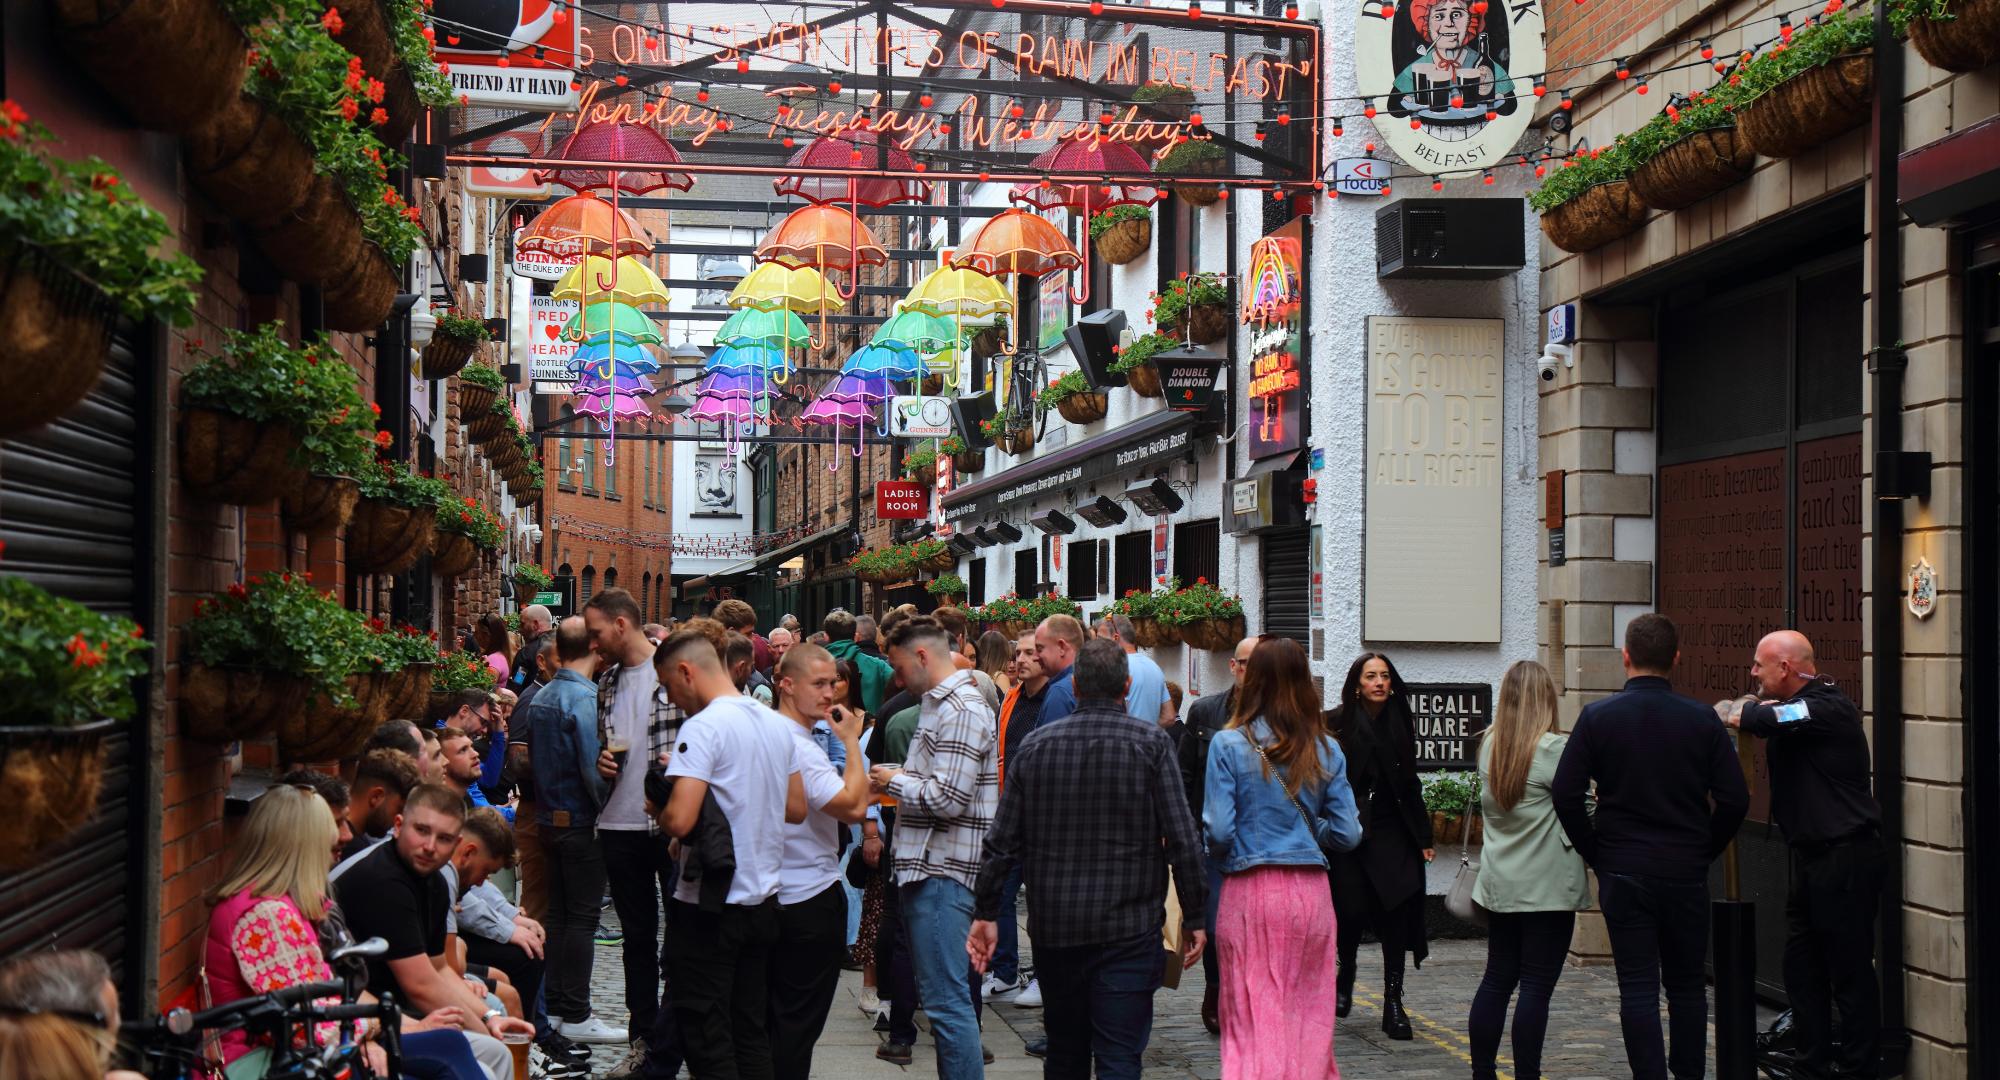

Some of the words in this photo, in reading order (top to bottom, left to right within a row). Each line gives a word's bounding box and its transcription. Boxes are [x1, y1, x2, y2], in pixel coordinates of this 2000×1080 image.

[613, 24, 691, 64] ONLY
[712, 23, 820, 64] SEVEN
[839, 26, 944, 68] TYPES
[959, 30, 1000, 69] OF
[1015, 34, 1094, 79] RAIN
[1107, 43, 1138, 84] IN
[452, 72, 503, 91] FRIEND
[507, 77, 524, 93] AT
[528, 79, 567, 96] HAND
[1413, 142, 1488, 167] BELFAST
[1344, 174, 1386, 191] focus
[518, 263, 531, 271] THE
[533, 264, 552, 273] DUKE
[554, 266, 564, 274] OF
[538, 311, 569, 322] RED
[532, 344, 578, 356] HEART
[1171, 367, 1209, 377] DOUBLE
[1375, 352, 1401, 391] IS
[1409, 353, 1497, 391] GOING
[1167, 378, 1212, 388] DIAMOND
[909, 426, 948, 434] GUINNESS
[1375, 392, 1431, 451] TO
[1444, 394, 1497, 450] BE
[1375, 453, 1417, 486] ALL
[1423, 454, 1497, 487] RIGHT
[884, 489, 921, 498] LADIES
[1700, 467, 1719, 498] the
[886, 502, 918, 511] ROOM
[1745, 504, 1784, 537] golden
[1802, 488, 1836, 530] and
[1711, 543, 1734, 573] and
[1736, 544, 1755, 572] the
[1759, 542, 1784, 571] dim
[1801, 538, 1830, 572] and
[1833, 536, 1857, 571] the
[1729, 581, 1756, 614] light
[1759, 580, 1783, 609] and
[1802, 579, 1834, 622] the
[1711, 617, 1755, 654] spread
[1699, 656, 1739, 698] being
[1406, 694, 1482, 714] NEGALL
[1418, 718, 1469, 737] UARE
[1415, 740, 1463, 760] ORTH
